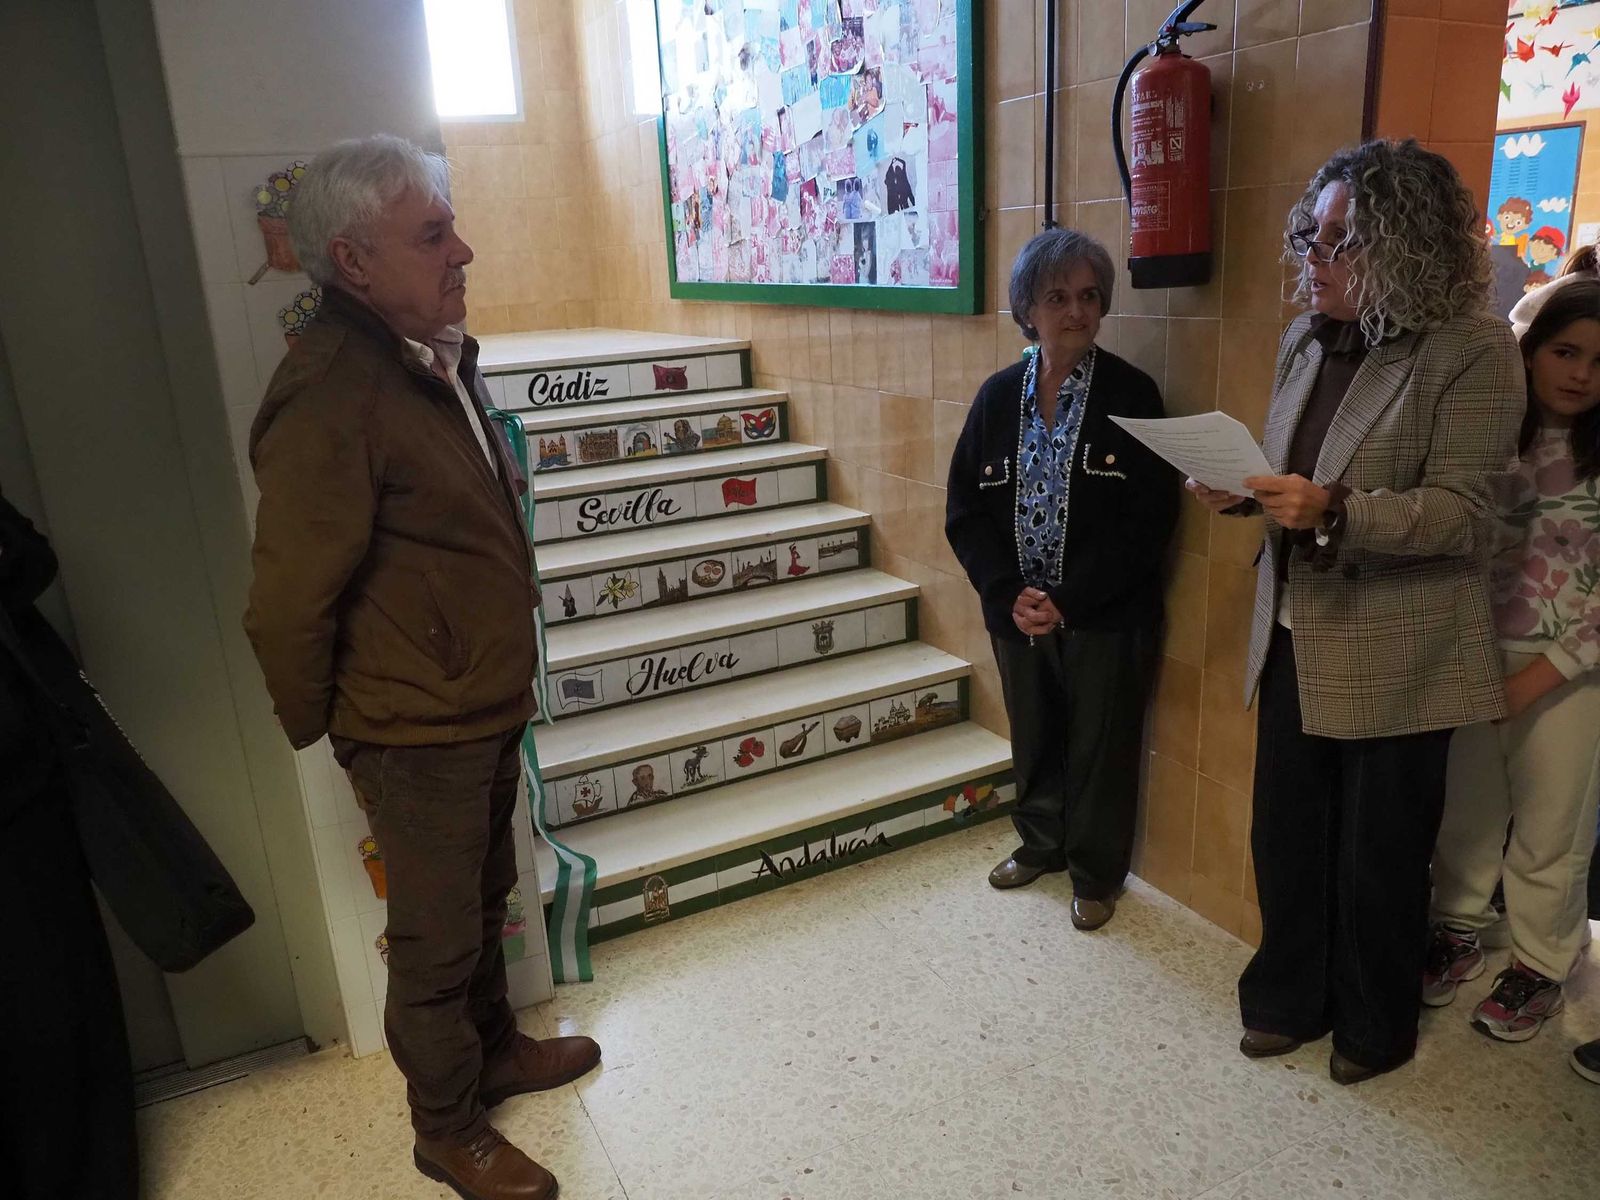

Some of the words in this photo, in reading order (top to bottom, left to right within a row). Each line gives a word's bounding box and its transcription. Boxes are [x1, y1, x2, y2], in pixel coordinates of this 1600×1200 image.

[528, 371, 610, 406] Cádiz
[577, 488, 681, 533] Sevilla
[626, 652, 740, 696] Huelva
[752, 820, 893, 884] Andalucía
